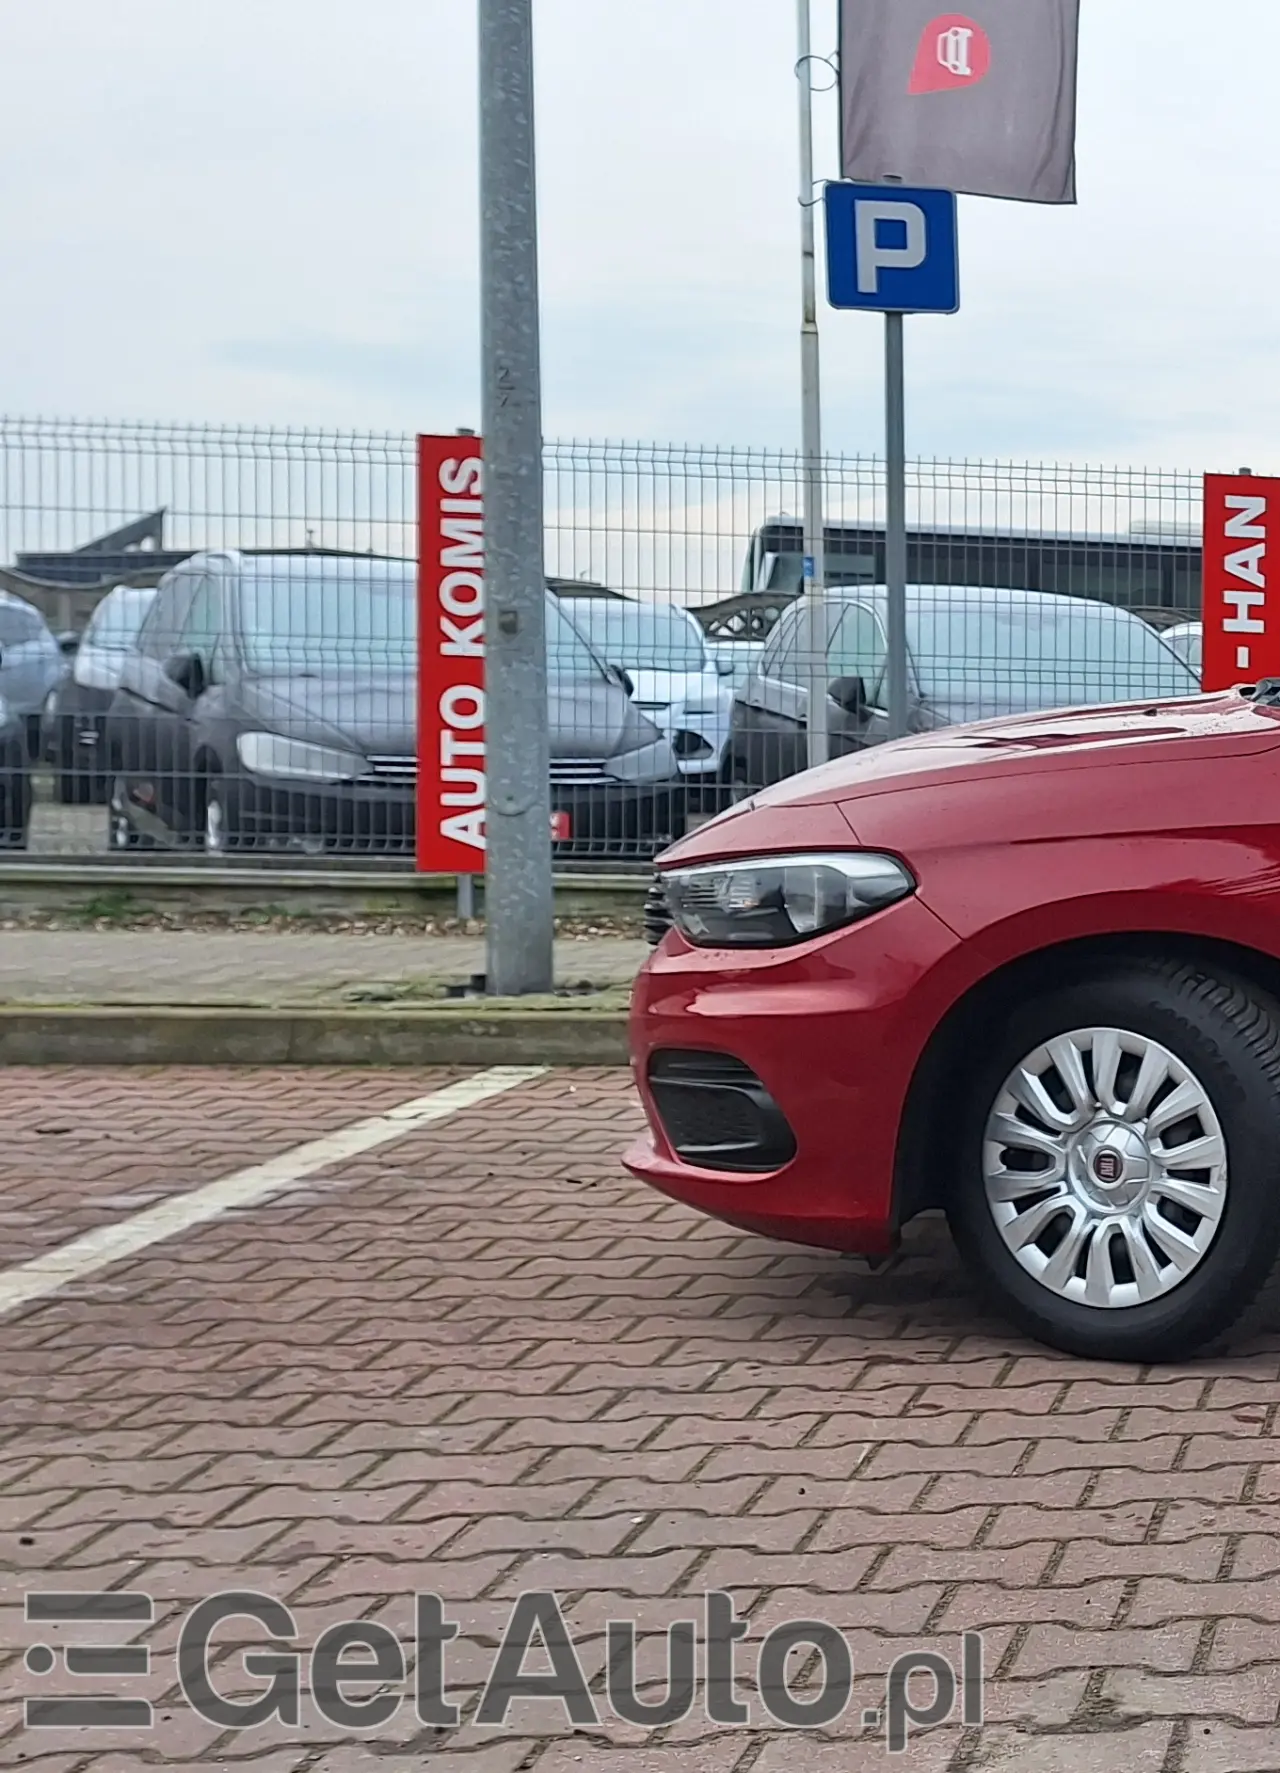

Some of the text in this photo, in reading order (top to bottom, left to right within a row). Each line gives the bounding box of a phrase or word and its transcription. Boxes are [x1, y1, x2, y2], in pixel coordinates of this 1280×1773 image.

[854, 199, 926, 294] P
[438, 456, 487, 851] AUTO KOMIS
